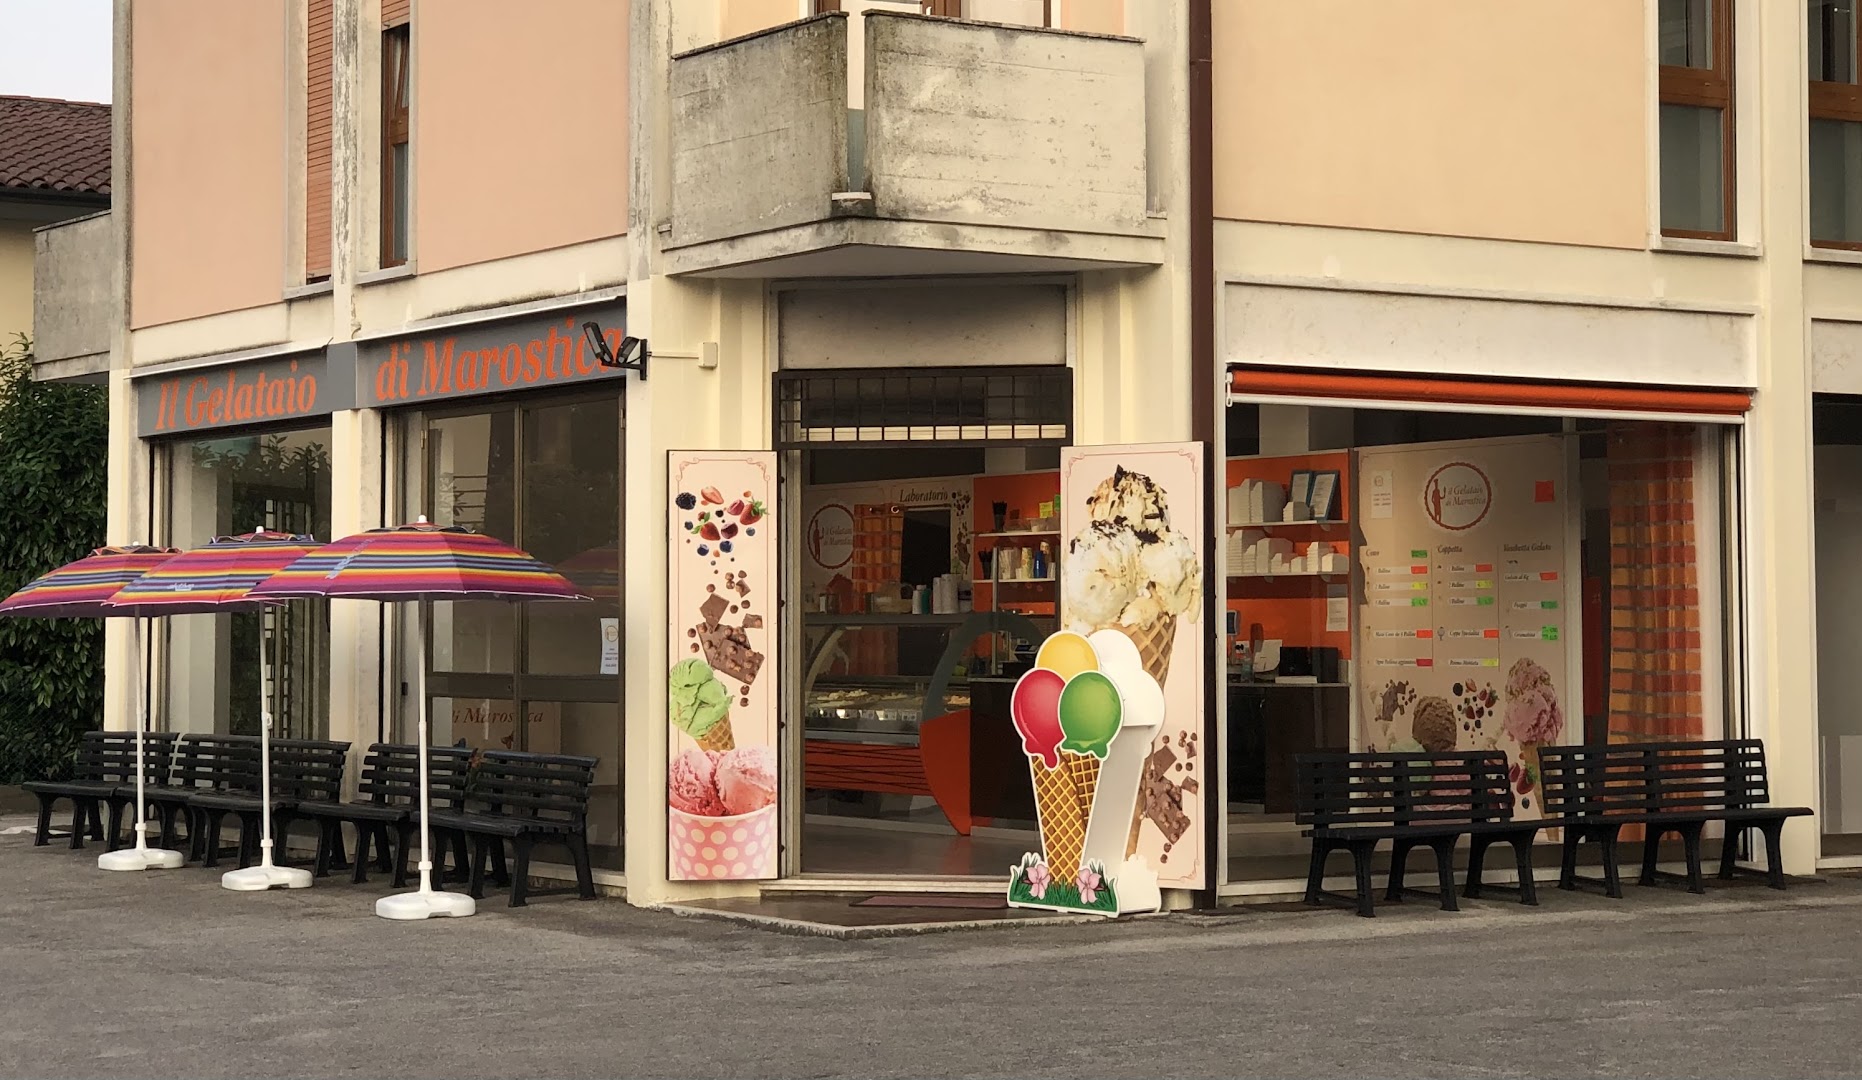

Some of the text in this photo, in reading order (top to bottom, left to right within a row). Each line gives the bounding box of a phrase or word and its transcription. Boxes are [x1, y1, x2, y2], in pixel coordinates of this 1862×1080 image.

[155, 376, 178, 431] Il
[184, 359, 317, 426] Gelataio
[376, 342, 411, 401] di
[899, 487, 949, 503] Laboratorio
